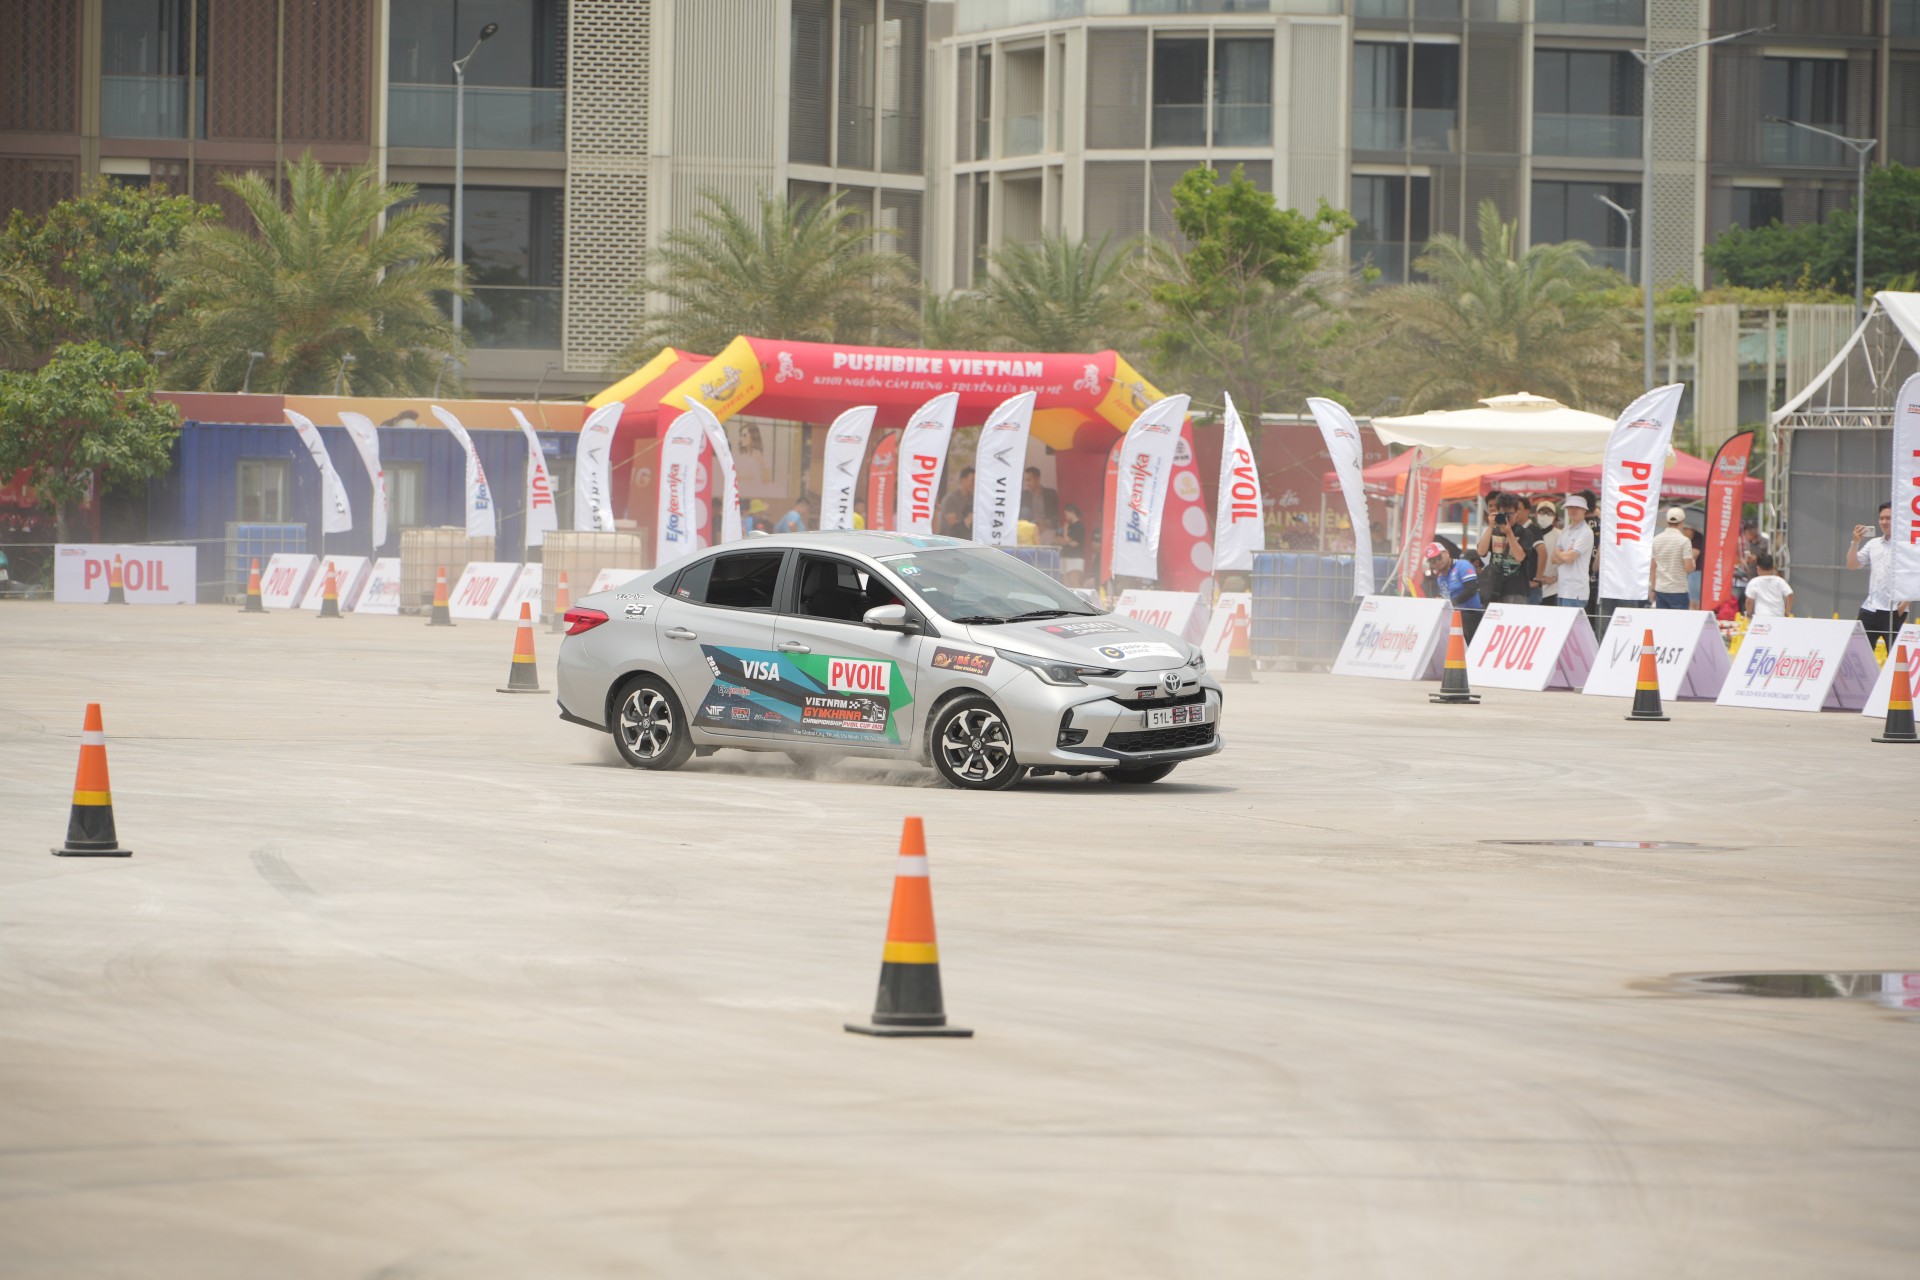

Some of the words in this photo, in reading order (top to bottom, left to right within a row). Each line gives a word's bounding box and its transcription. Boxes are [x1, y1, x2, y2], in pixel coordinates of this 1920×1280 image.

[833, 352, 944, 374] PUSHBIKE
[948, 358, 1044, 378] VIETNAM
[911, 454, 938, 523] PVOIL
[1126, 452, 1153, 544] Ekokemika
[1231, 448, 1258, 524] PVOIL
[666, 463, 684, 542] Ekokemika
[1616, 460, 1652, 546] PVOIL
[264, 567, 298, 596] PVOIL
[457, 576, 500, 606] PVOIL
[624, 604, 653, 614] PST
[1355, 623, 1418, 662] Ekokemika
[1478, 625, 1546, 671] PVOIL
[1630, 645, 1684, 665] VIFAST
[706, 655, 721, 677] 2026
[739, 659, 780, 681] VISA
[832, 662, 886, 691] PVOIL
[1745, 647, 1825, 690] Ekokemika
[803, 706, 862, 720] GYMKHANA
[805, 697, 848, 708] VIETNAM
[802, 718, 842, 727] CHAMPIONSHIP
